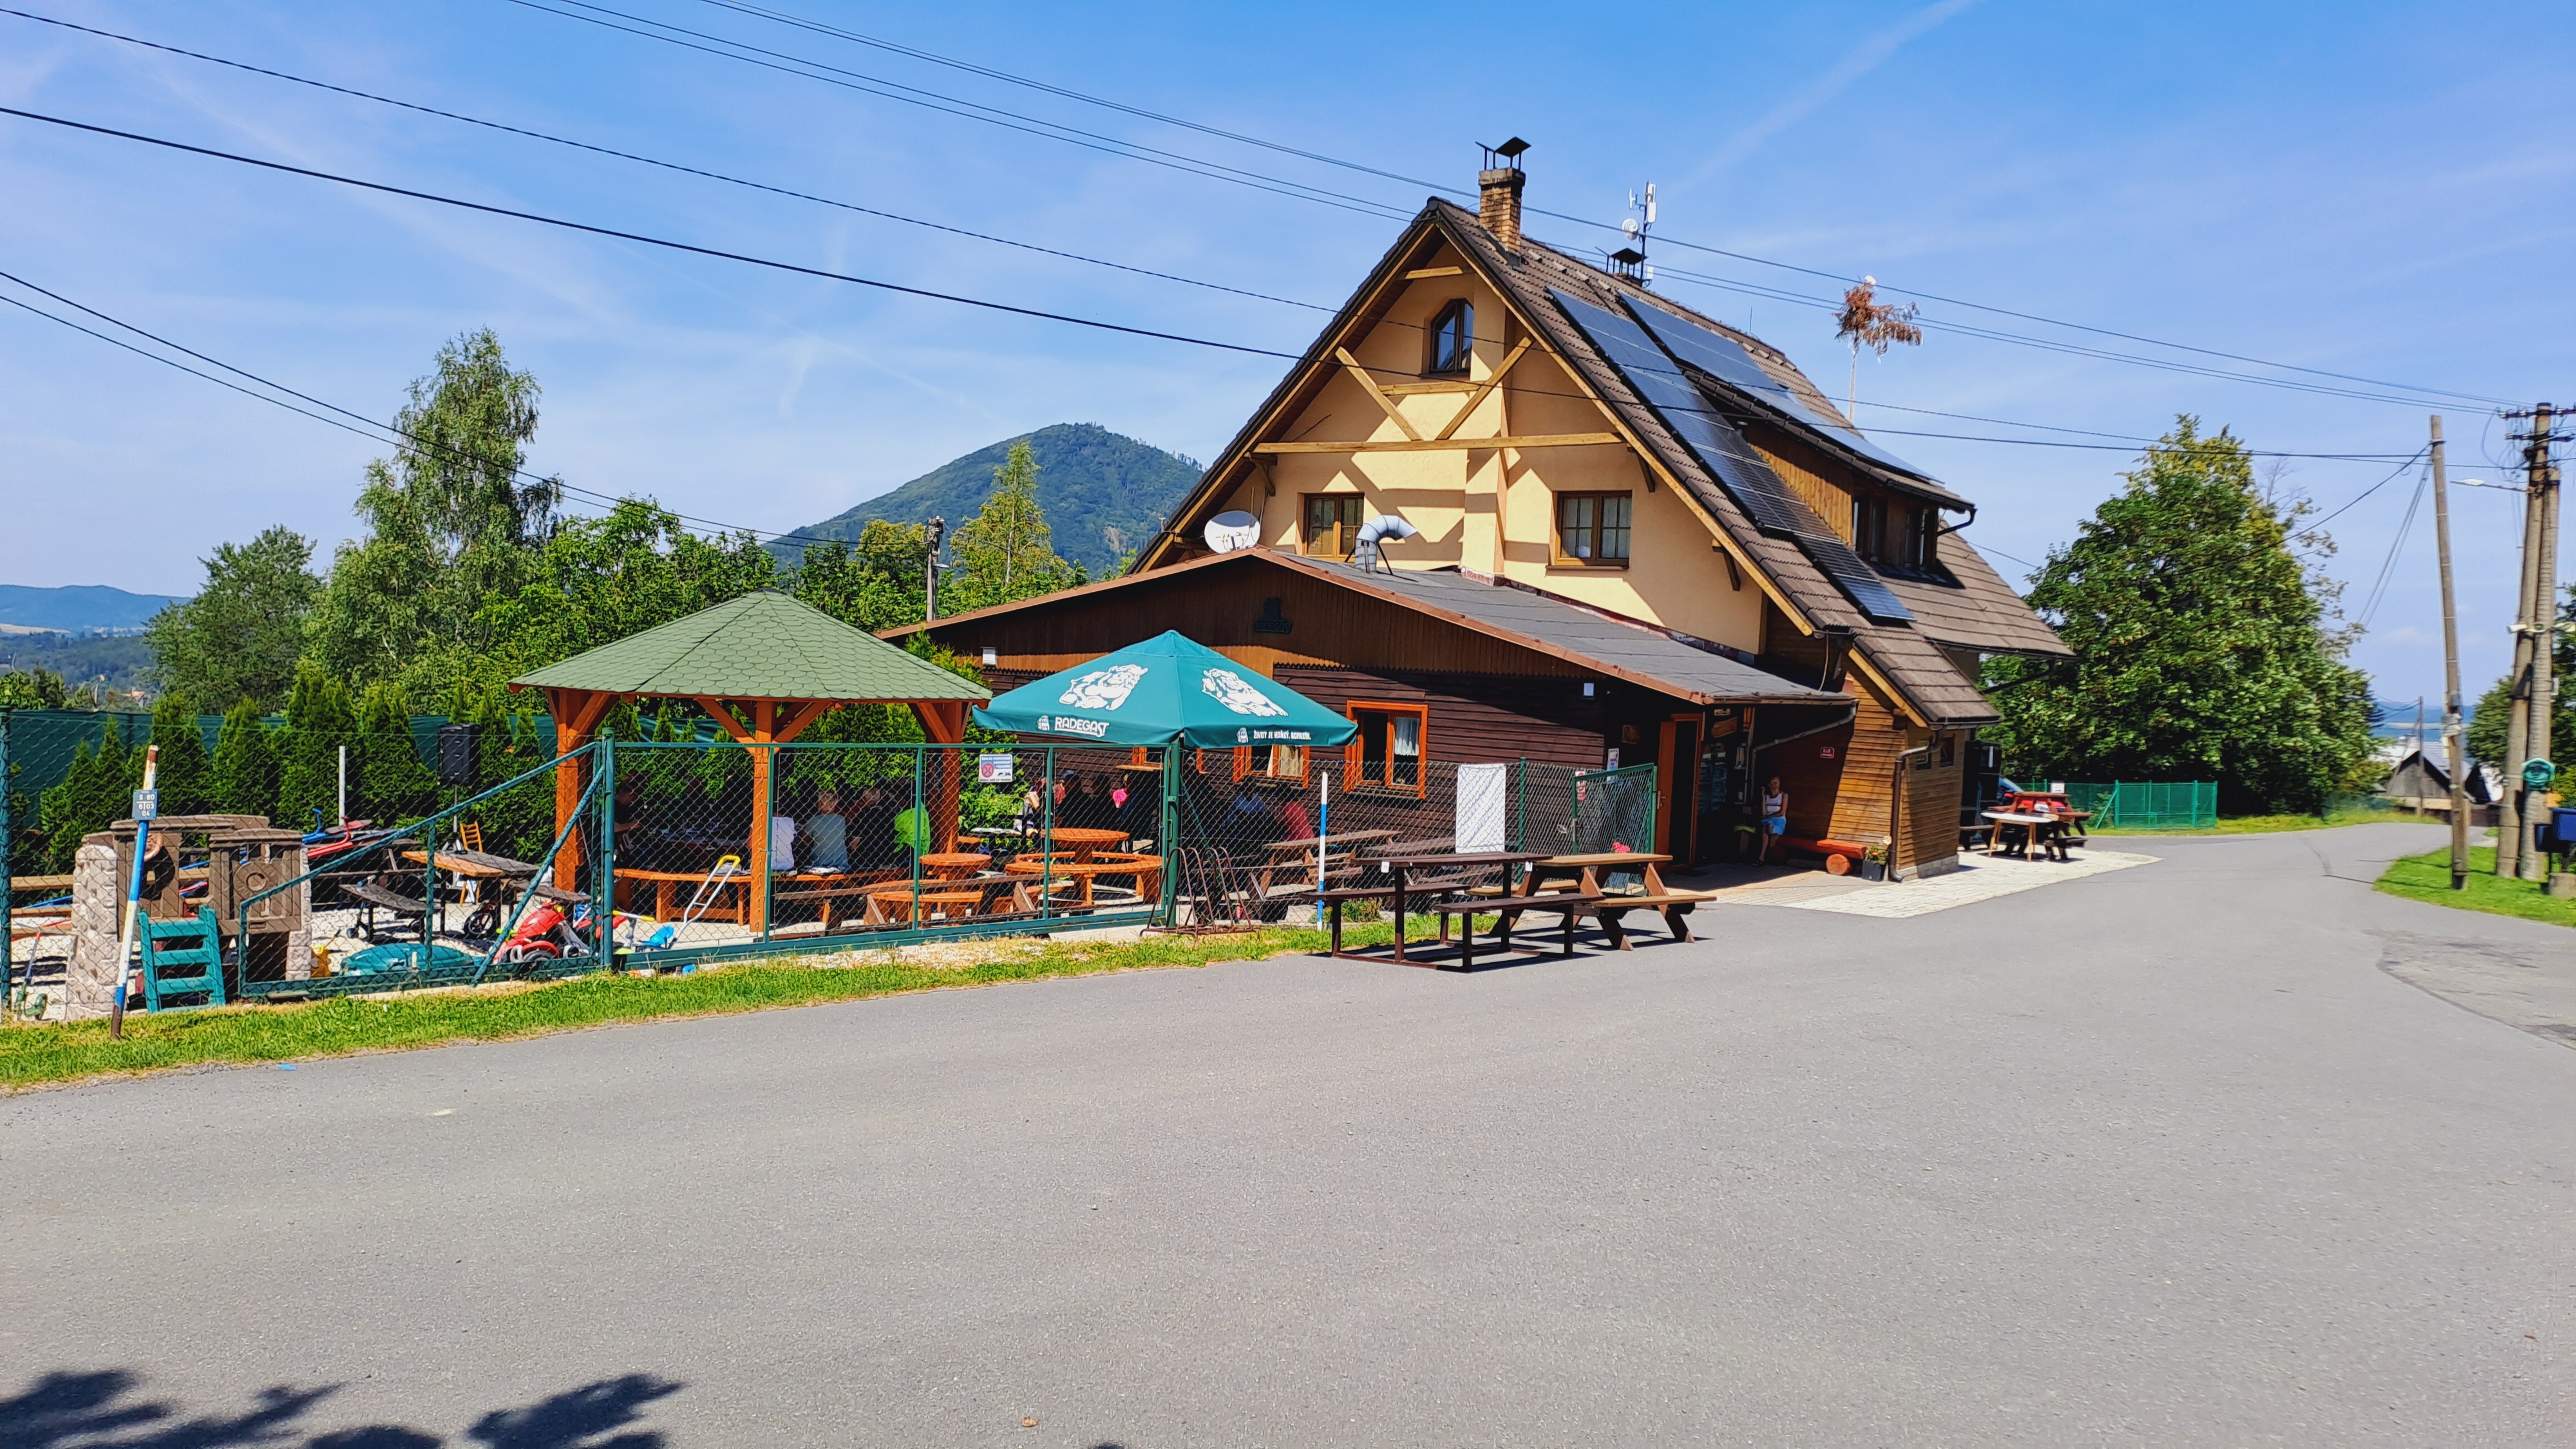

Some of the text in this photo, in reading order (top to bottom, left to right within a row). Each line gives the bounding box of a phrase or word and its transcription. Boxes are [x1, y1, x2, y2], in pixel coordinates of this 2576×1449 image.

[1055, 717, 1110, 737] RADEGAST
[1253, 730, 1267, 739] ŽIVOT
[1268, 731, 1273, 739] JE
